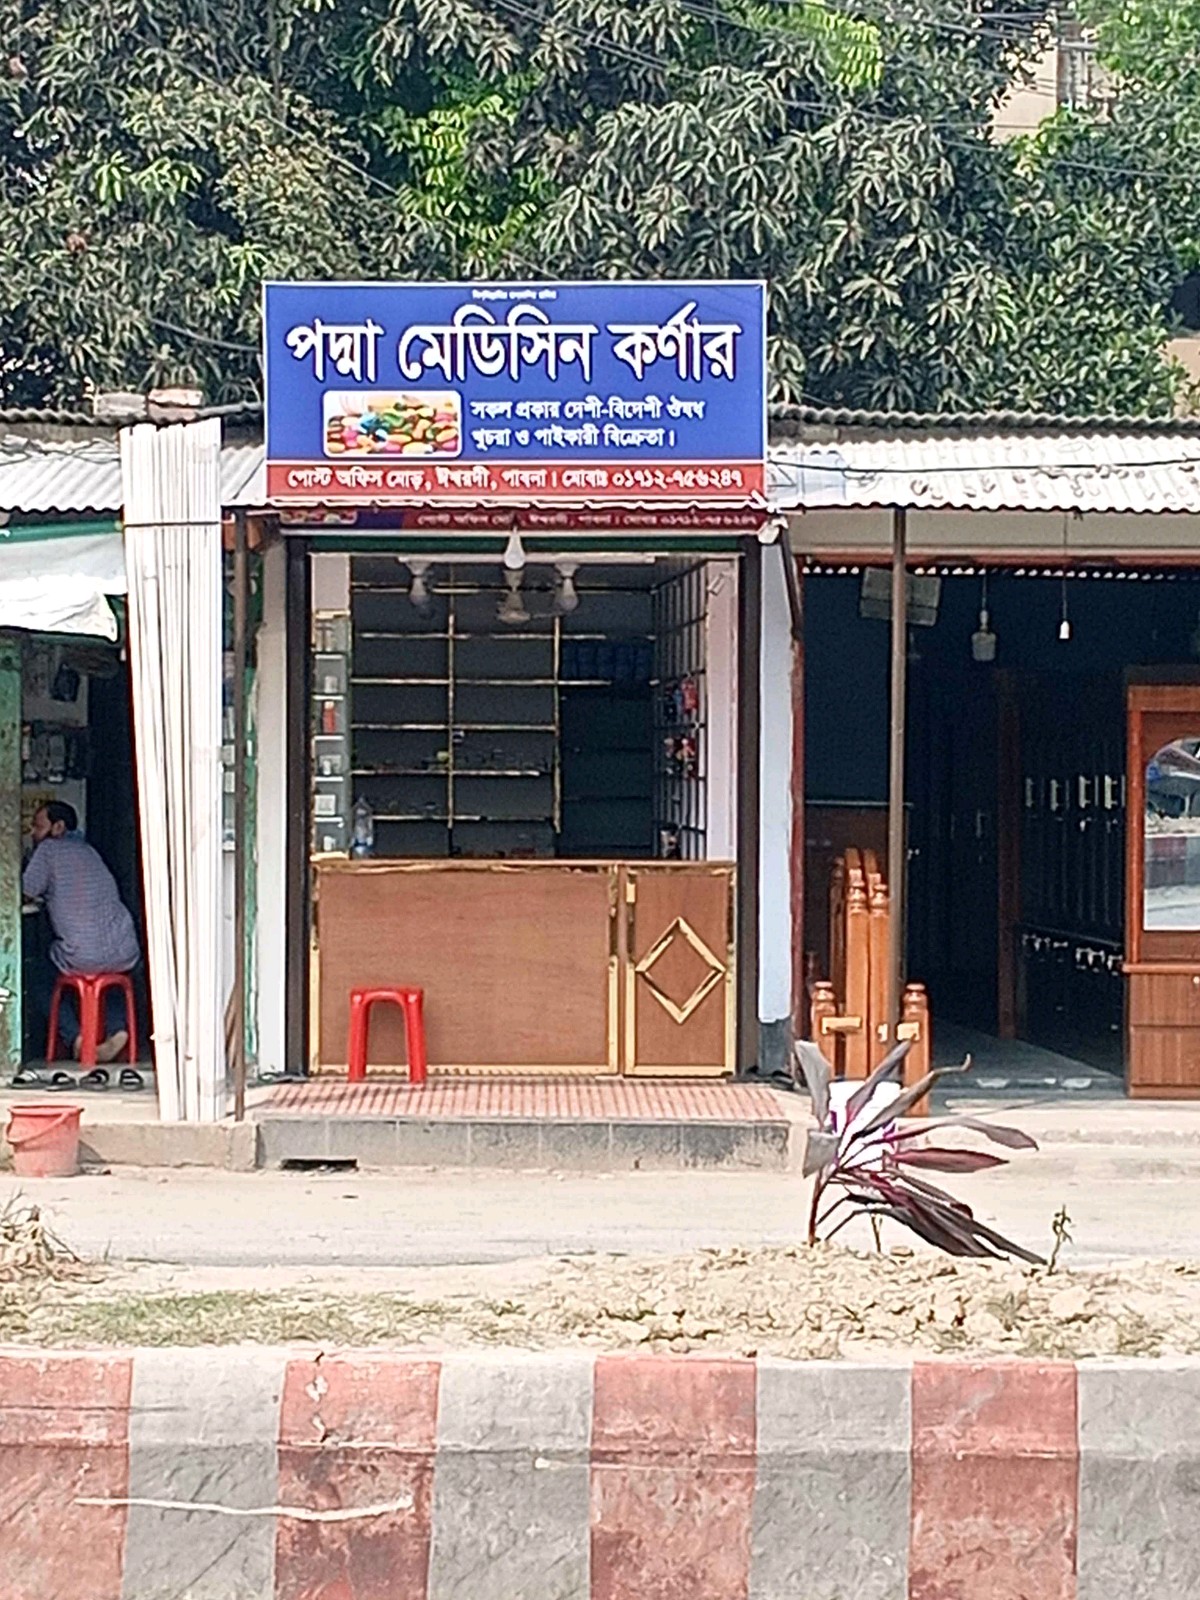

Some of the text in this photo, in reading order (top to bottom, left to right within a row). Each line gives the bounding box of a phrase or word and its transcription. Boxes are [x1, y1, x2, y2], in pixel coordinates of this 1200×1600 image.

[286, 301, 743, 384] পদ্মা মেডিসিন কর্ণার
[470, 395, 705, 420] সকল প্রকার দেশী-বিদেশী ঔষধ
[471, 428, 512, 451] খুচরা
[515, 429, 530, 446] ও
[534, 423, 600, 447] পাইকারী
[288, 467, 332, 487] পোস্ট
[336, 467, 383, 488] অফিস
[612, 469, 743, 489] ০১৭১২-৭৫৬২৪৭
